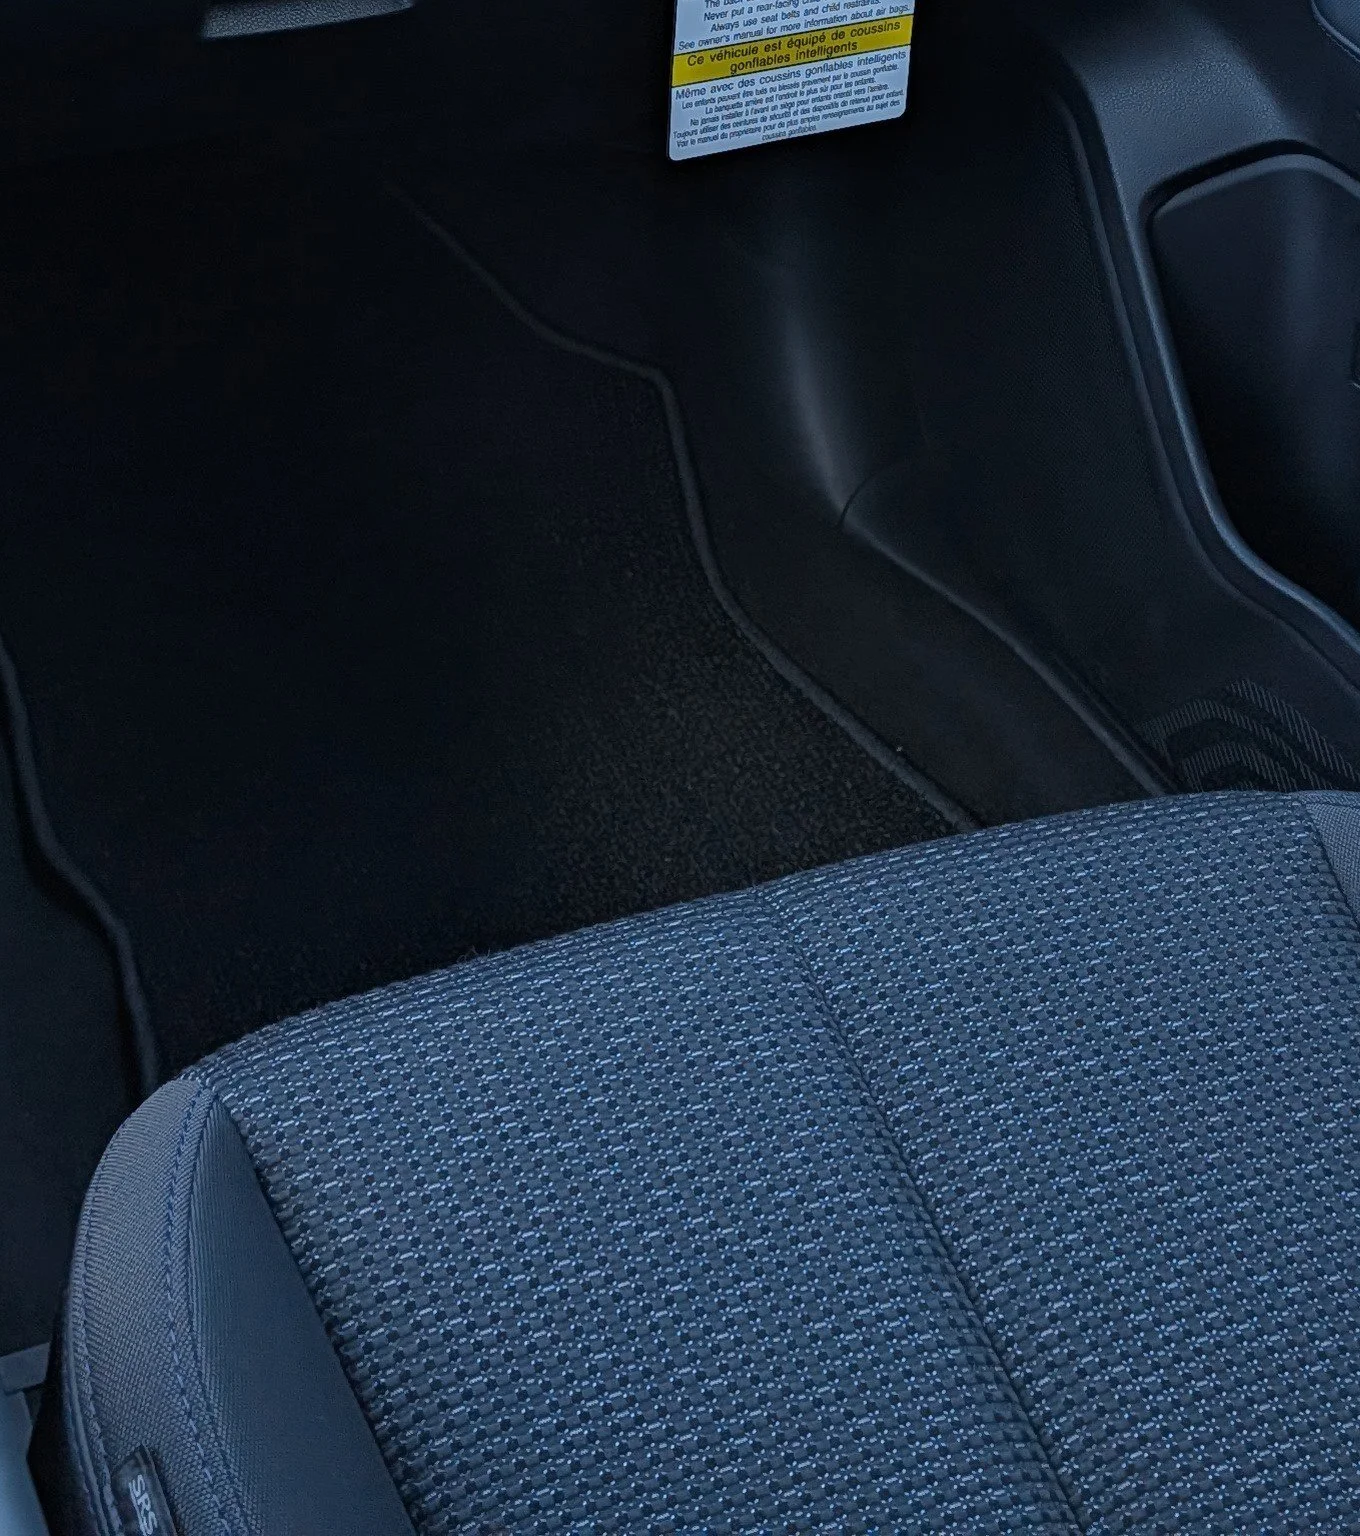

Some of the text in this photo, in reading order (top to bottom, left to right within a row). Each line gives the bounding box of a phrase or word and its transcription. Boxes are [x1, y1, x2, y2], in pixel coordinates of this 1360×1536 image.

[703, 10, 728, 21] Never
[731, 7, 745, 18] put
[704, 0, 720, 8] The
[710, 20, 740, 32] Always
[743, 18, 758, 27] use
[760, 14, 778, 24] seat
[781, 9, 800, 20] belts
[803, 6, 819, 17] and
[679, 41, 695, 51] See
[698, 33, 730, 47] owner's
[733, 29, 764, 41] manual
[766, 26, 778, 35] for
[780, 22, 801, 32] more
[804, 14, 848, 29] information
[850, 8, 873, 20] about
[876, 6, 886, 15] air
[687, 21, 901, 67] Ce véhicule est équipé de coussins
[675, 51, 906, 100] Même avec des coussins gonflables intelligents
[730, 41, 858, 75] gonflables intelligents
[131, 1474, 158, 1535] SRS
